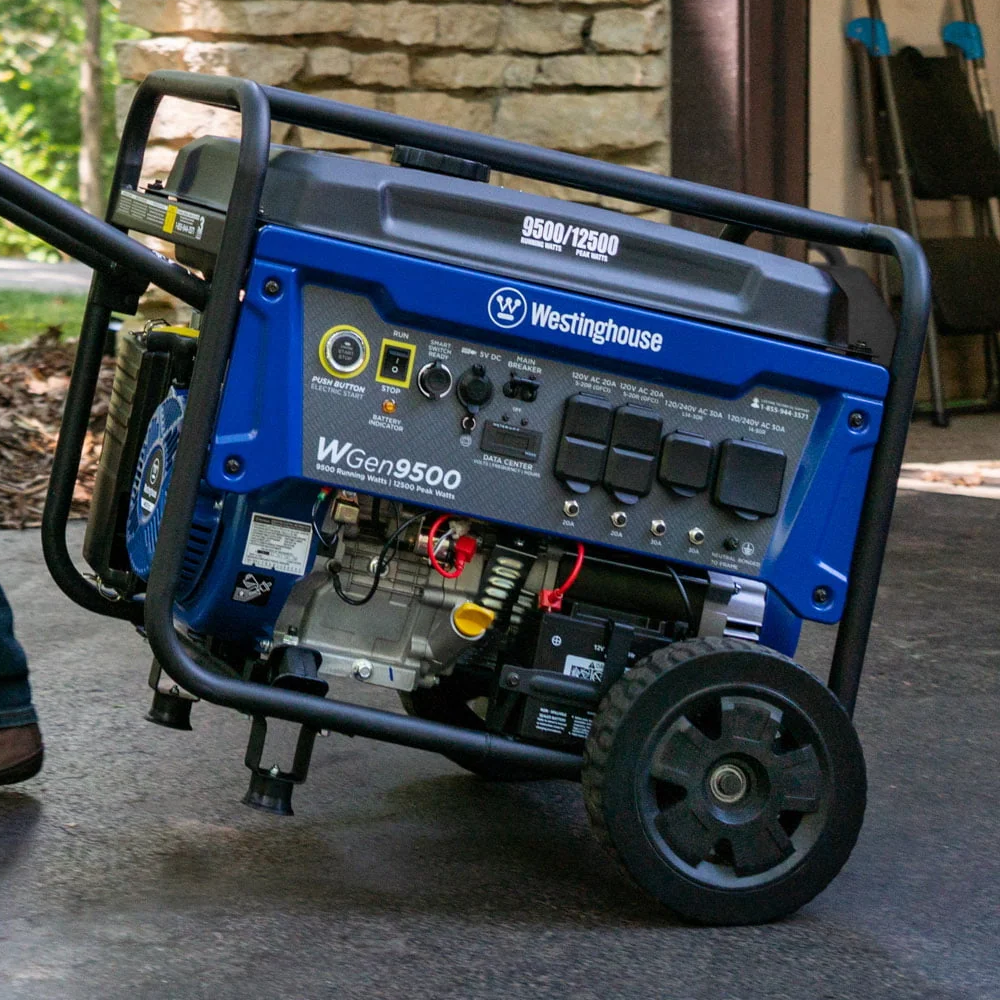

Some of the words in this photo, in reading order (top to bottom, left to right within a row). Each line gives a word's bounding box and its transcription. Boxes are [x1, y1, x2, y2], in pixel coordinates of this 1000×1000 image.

[522, 215, 619, 256] 9500/12500
[576, 248, 590, 258] PEAK
[531, 302, 663, 352] Westinghouse
[393, 330, 409, 339] RUN
[428, 345, 452, 355] SWITCH
[430, 340, 451, 348] SMART
[428, 351, 449, 360] READY
[516, 356, 536, 365] MAIN
[508, 361, 542, 374] BREAKER
[311, 376, 333, 386] PUSH
[334, 380, 366, 393] BUTTON
[572, 371, 589, 381] 120V
[602, 378, 616, 387] 20A
[311, 383, 341, 395] ELECTRIC
[343, 390, 364, 399] START
[381, 385, 401, 394] STOP
[620, 383, 636, 392] 120V
[638, 386, 648, 394] AC
[650, 389, 664, 398] 20A
[665, 400, 697, 413] 120/240V
[698, 407, 708, 415] AC
[710, 410, 722, 419] 30A
[369, 420, 403, 432] INDICATOR
[372, 414, 402, 425] BATTERY
[727, 414, 760, 427] 120/240V
[317, 436, 461, 490] WGen9500
[483, 454, 502, 463] DATA
[504, 458, 533, 471] CENTER
[316, 463, 336, 473] 9500
[336, 468, 365, 480] Running
[367, 474, 387, 485] Watts
[393, 480, 415, 491] 12500
[416, 485, 433, 495] Peak
[435, 490, 455, 500] Watts
